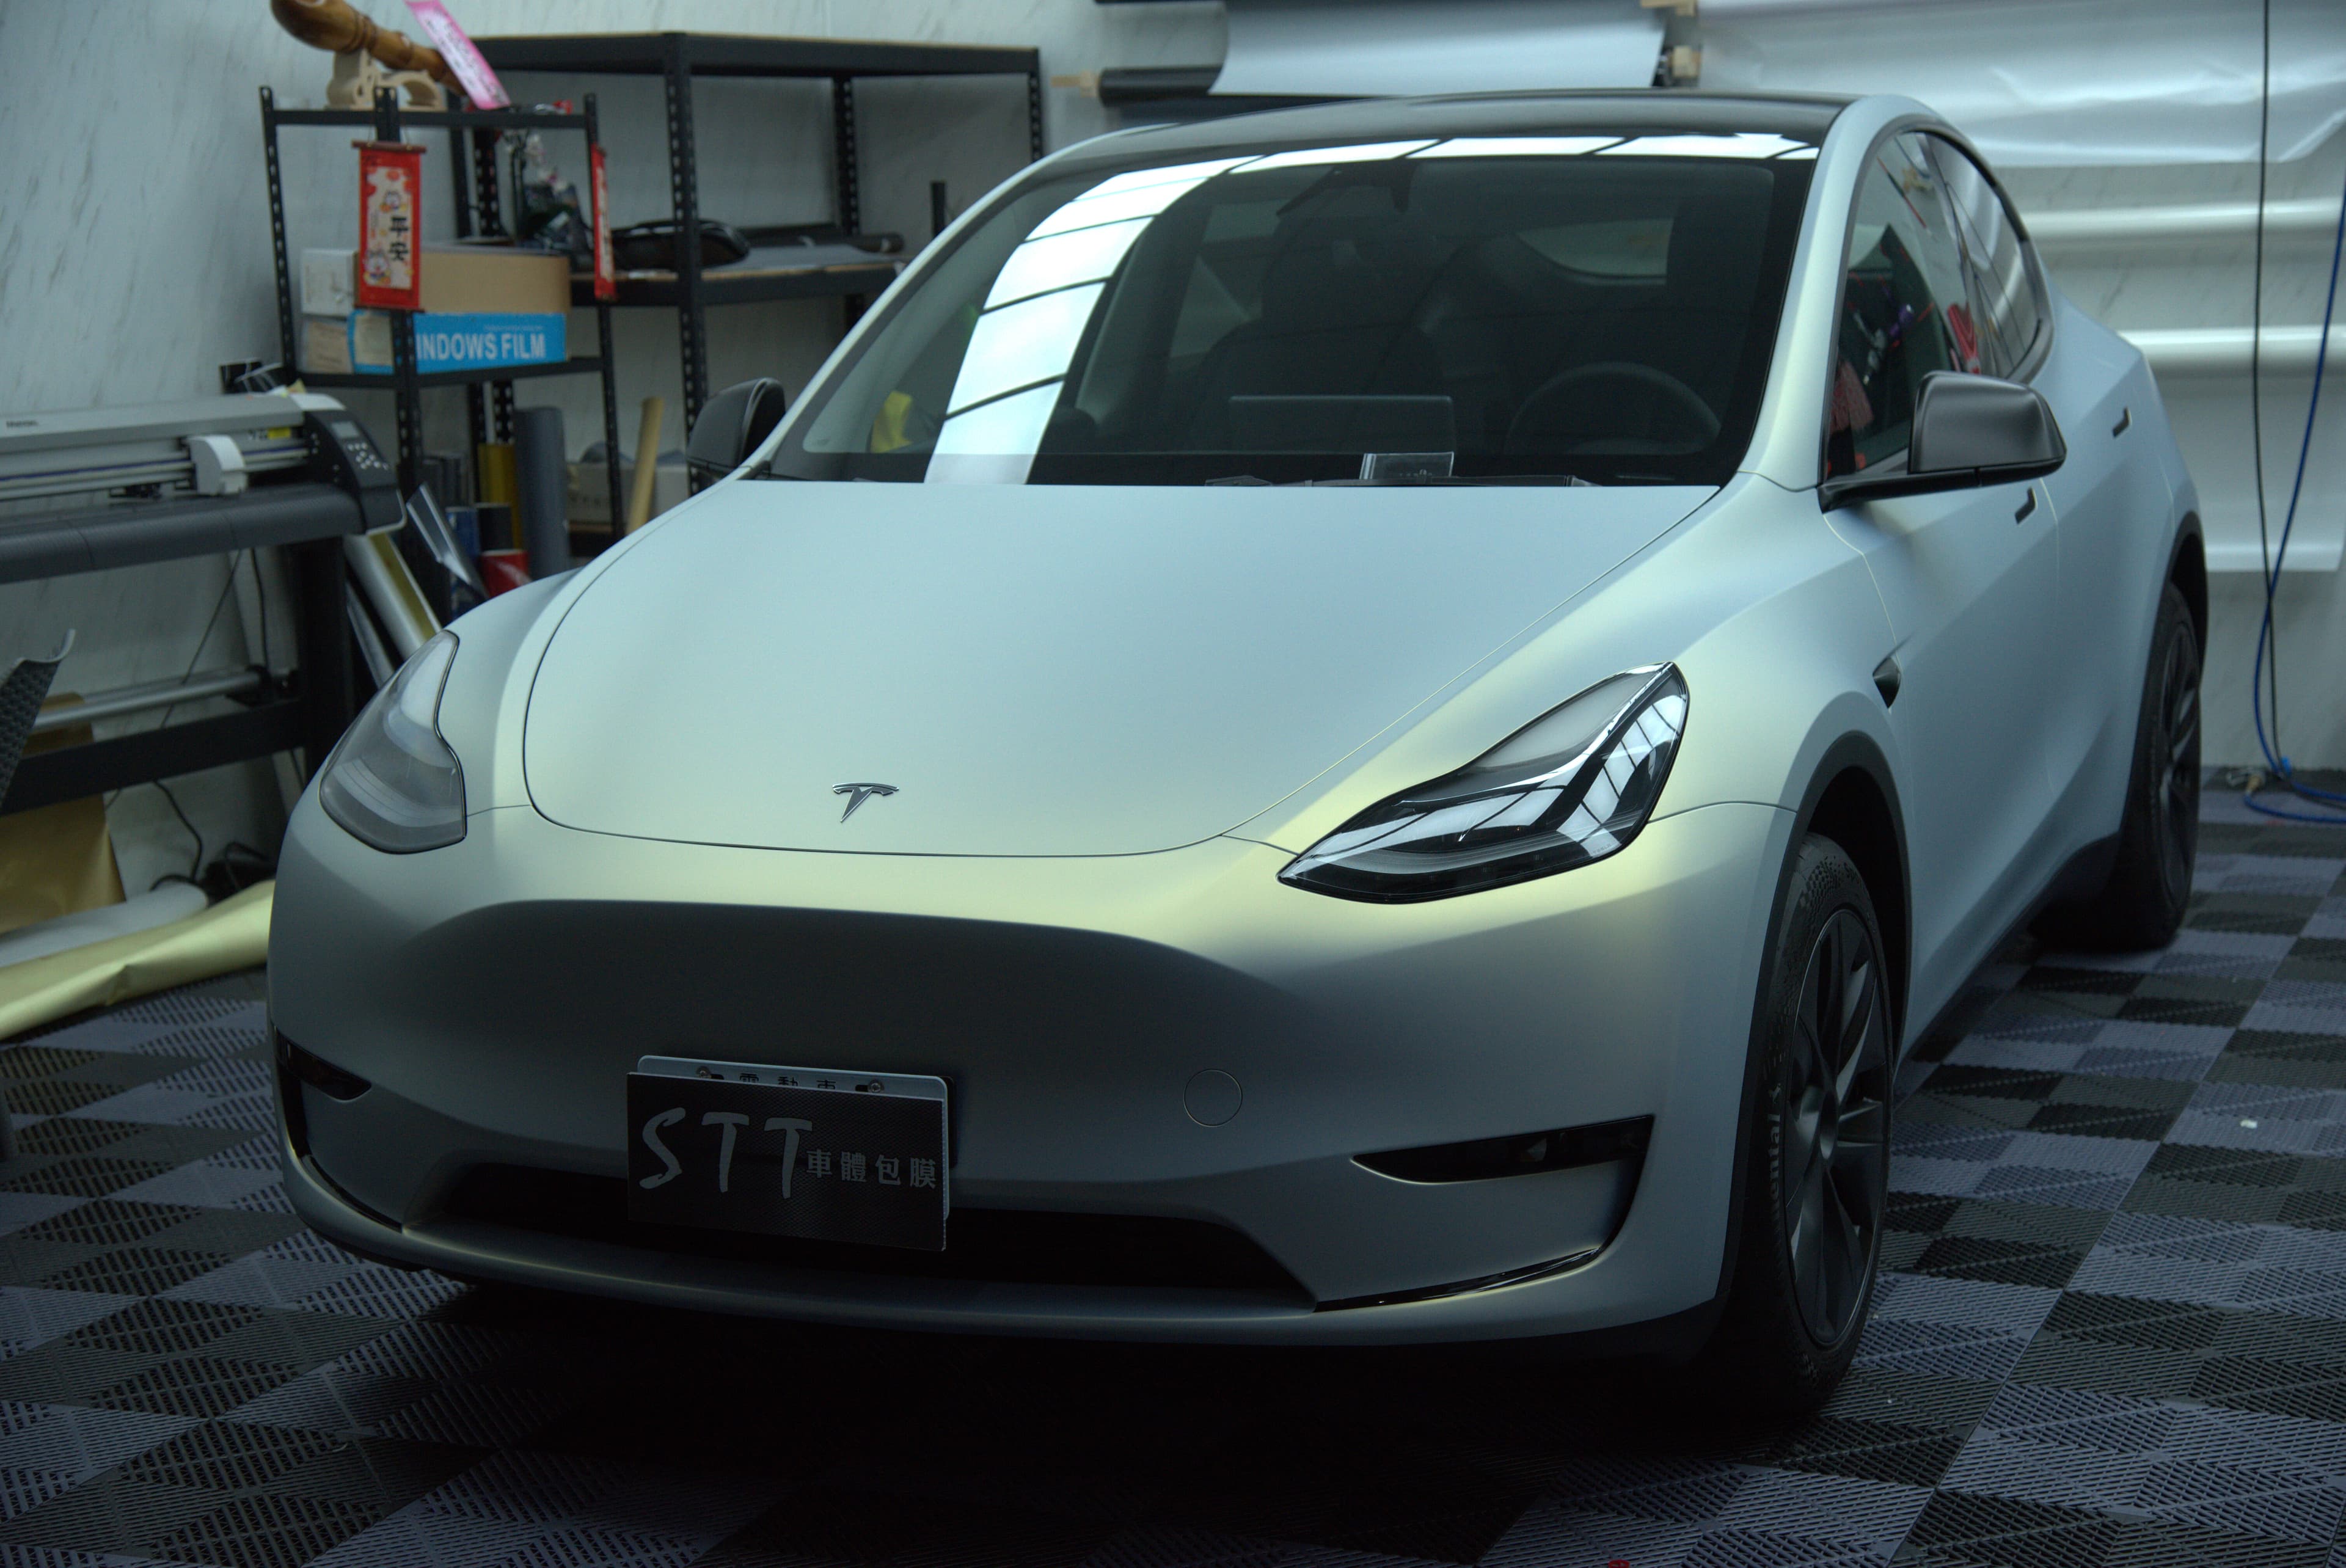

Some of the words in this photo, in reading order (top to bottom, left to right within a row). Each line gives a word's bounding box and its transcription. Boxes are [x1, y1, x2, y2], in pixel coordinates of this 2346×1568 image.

[389, 216, 408, 261] 平安
[416, 332, 499, 360] INDOWS
[501, 332, 546, 359] FILM
[639, 1107, 813, 1199] STT
[806, 1148, 937, 1189] 車體包膜
